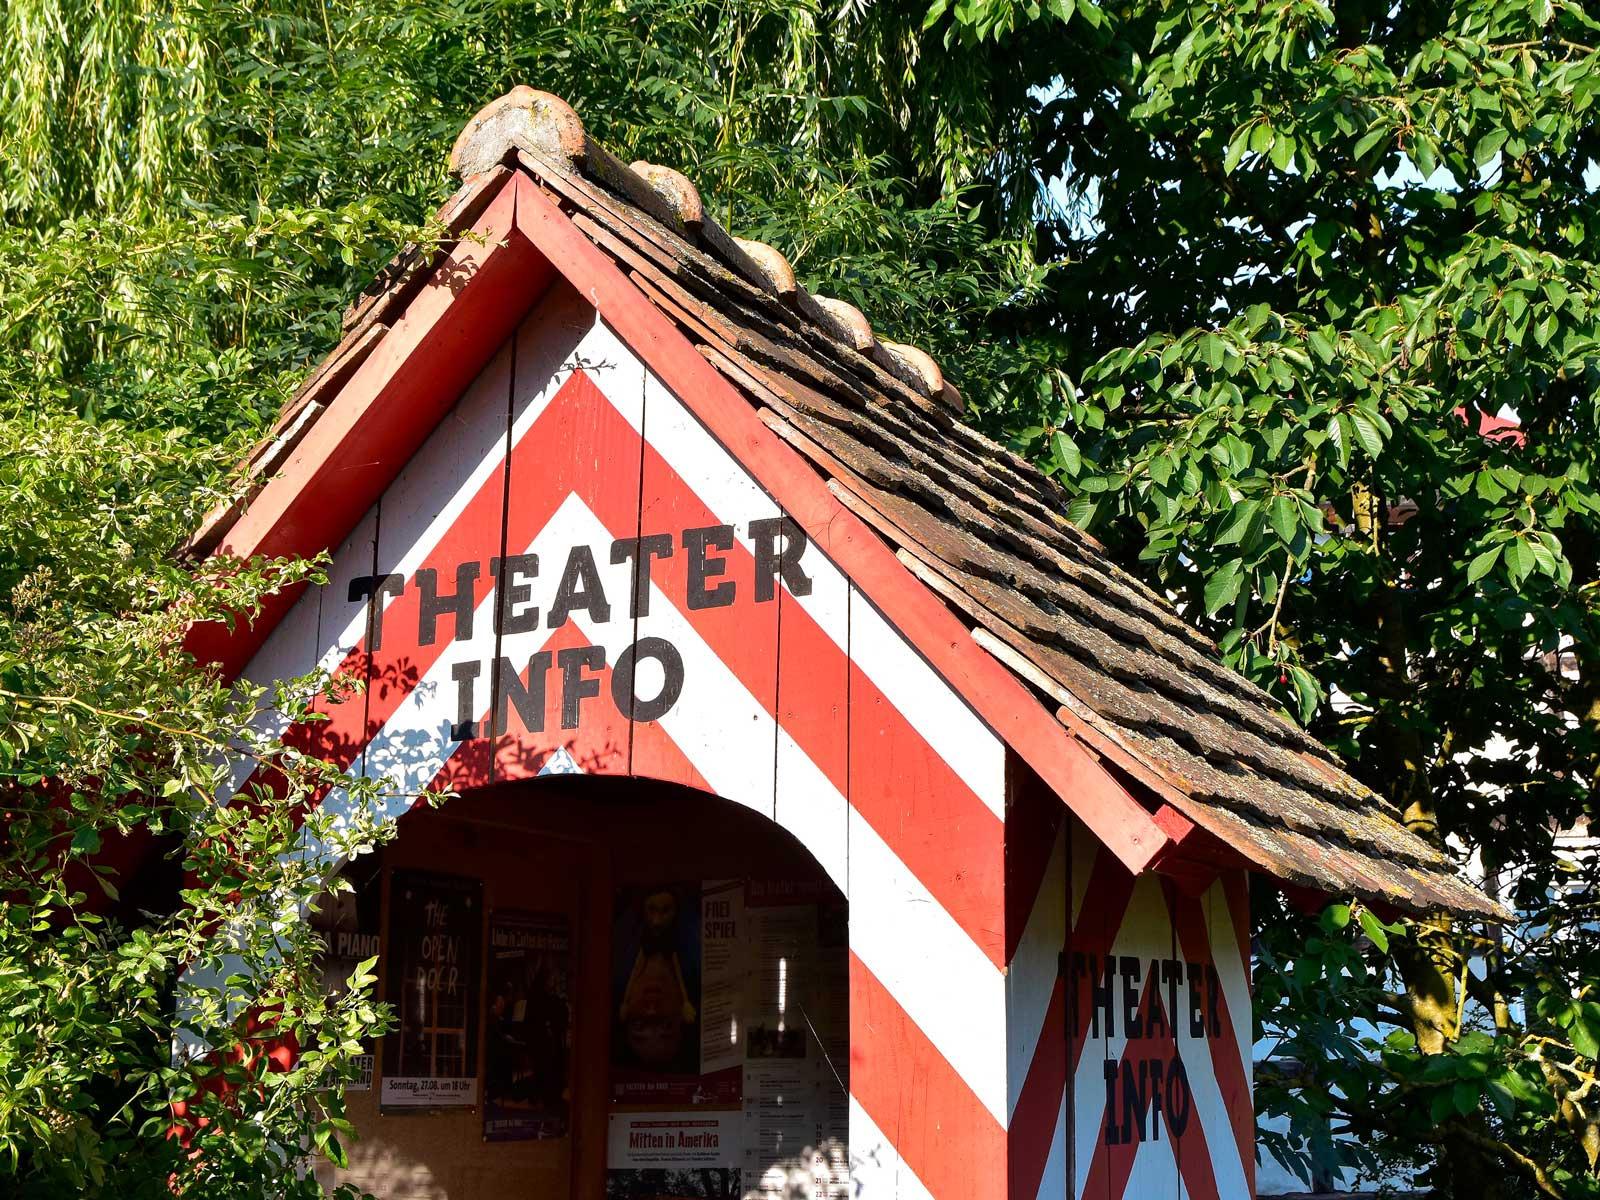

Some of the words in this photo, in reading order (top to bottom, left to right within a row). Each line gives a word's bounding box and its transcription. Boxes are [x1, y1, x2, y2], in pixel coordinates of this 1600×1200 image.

[348, 516, 813, 652] THEATER
[451, 637, 685, 742] INFO
[424, 898, 449, 928] THE
[338, 932, 381, 957] PIANO
[705, 921, 737, 939] SPIEL
[422, 934, 460, 964] OPEN
[1058, 952, 1221, 1039] THEATER
[389, 1080, 419, 1093] Sonntag,
[441, 1082, 451, 1091] um
[459, 1080, 471, 1091] Uhr
[1104, 1056, 1189, 1145] INFO
[629, 1132, 663, 1149] Mitten
[665, 1132, 675, 1149] in
[678, 1131, 719, 1148] Amerika
